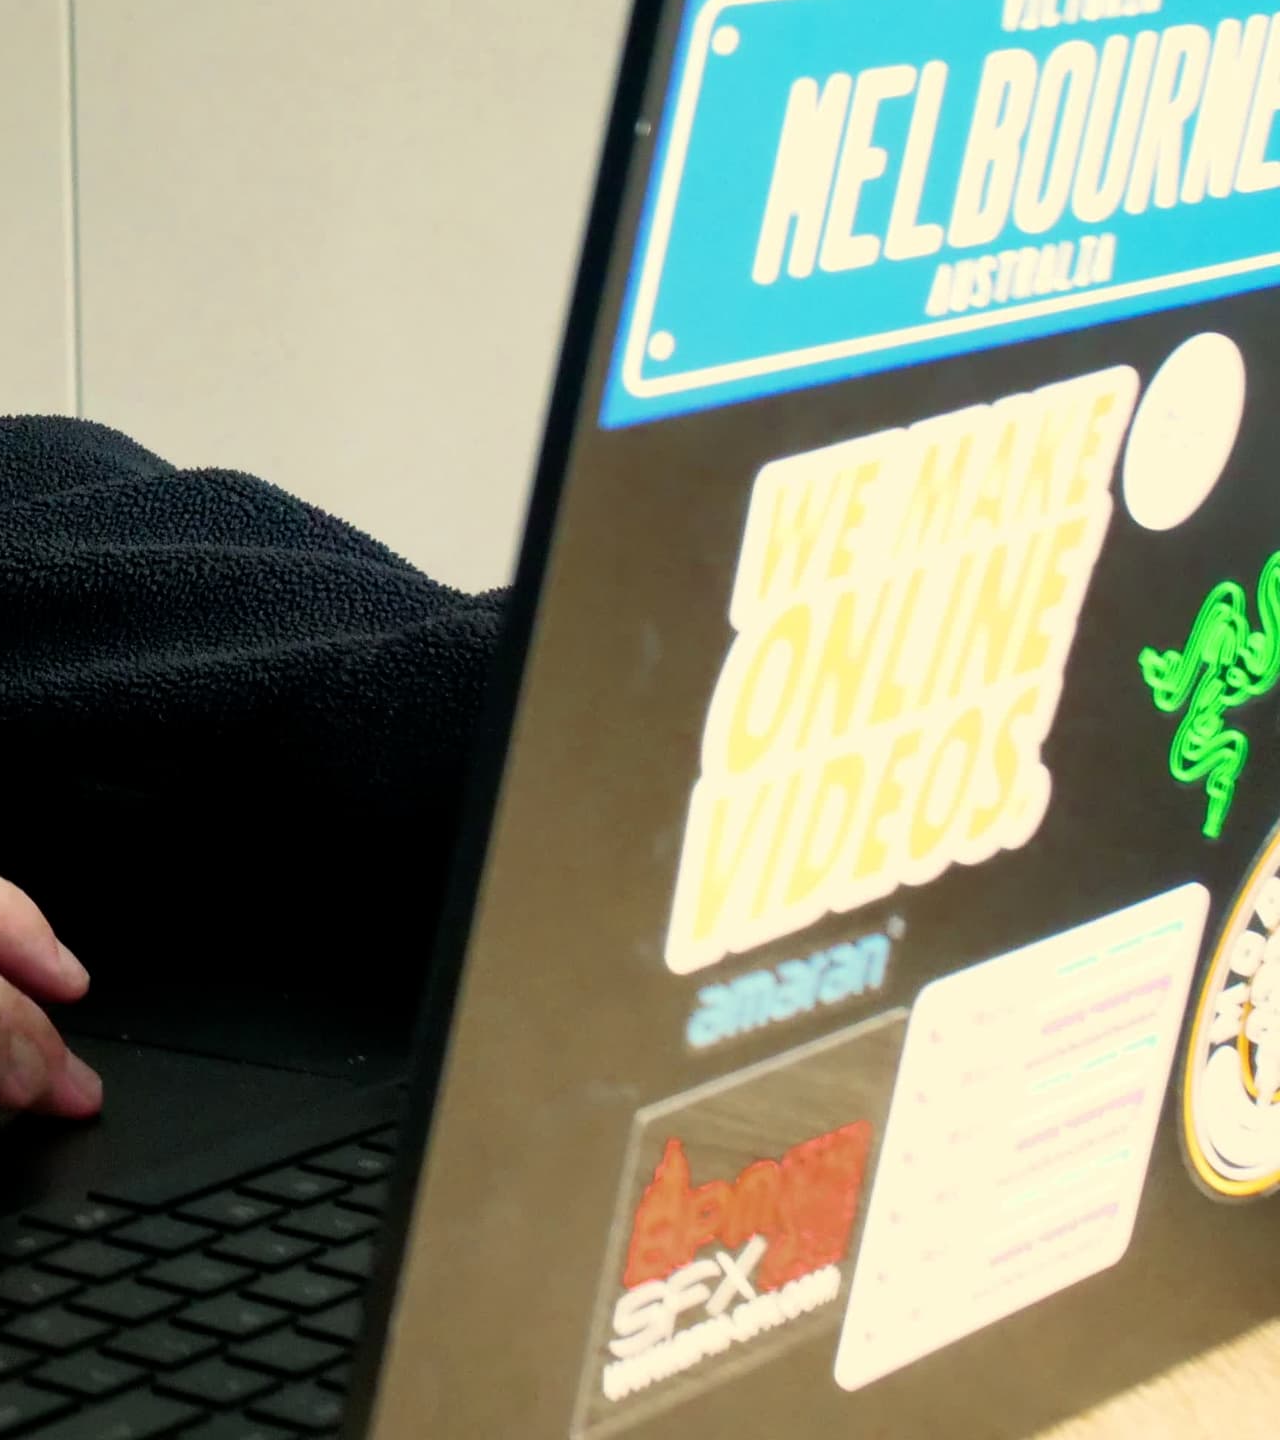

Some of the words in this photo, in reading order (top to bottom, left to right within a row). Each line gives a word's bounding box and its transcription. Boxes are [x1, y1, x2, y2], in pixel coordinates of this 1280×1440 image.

[925, 232, 1117, 317] AUSTRALIA
[757, 458, 883, 603] WE
[890, 390, 1118, 561] MAKE
[725, 514, 1089, 776] ONLINE
[608, 1232, 768, 1360] SFX
